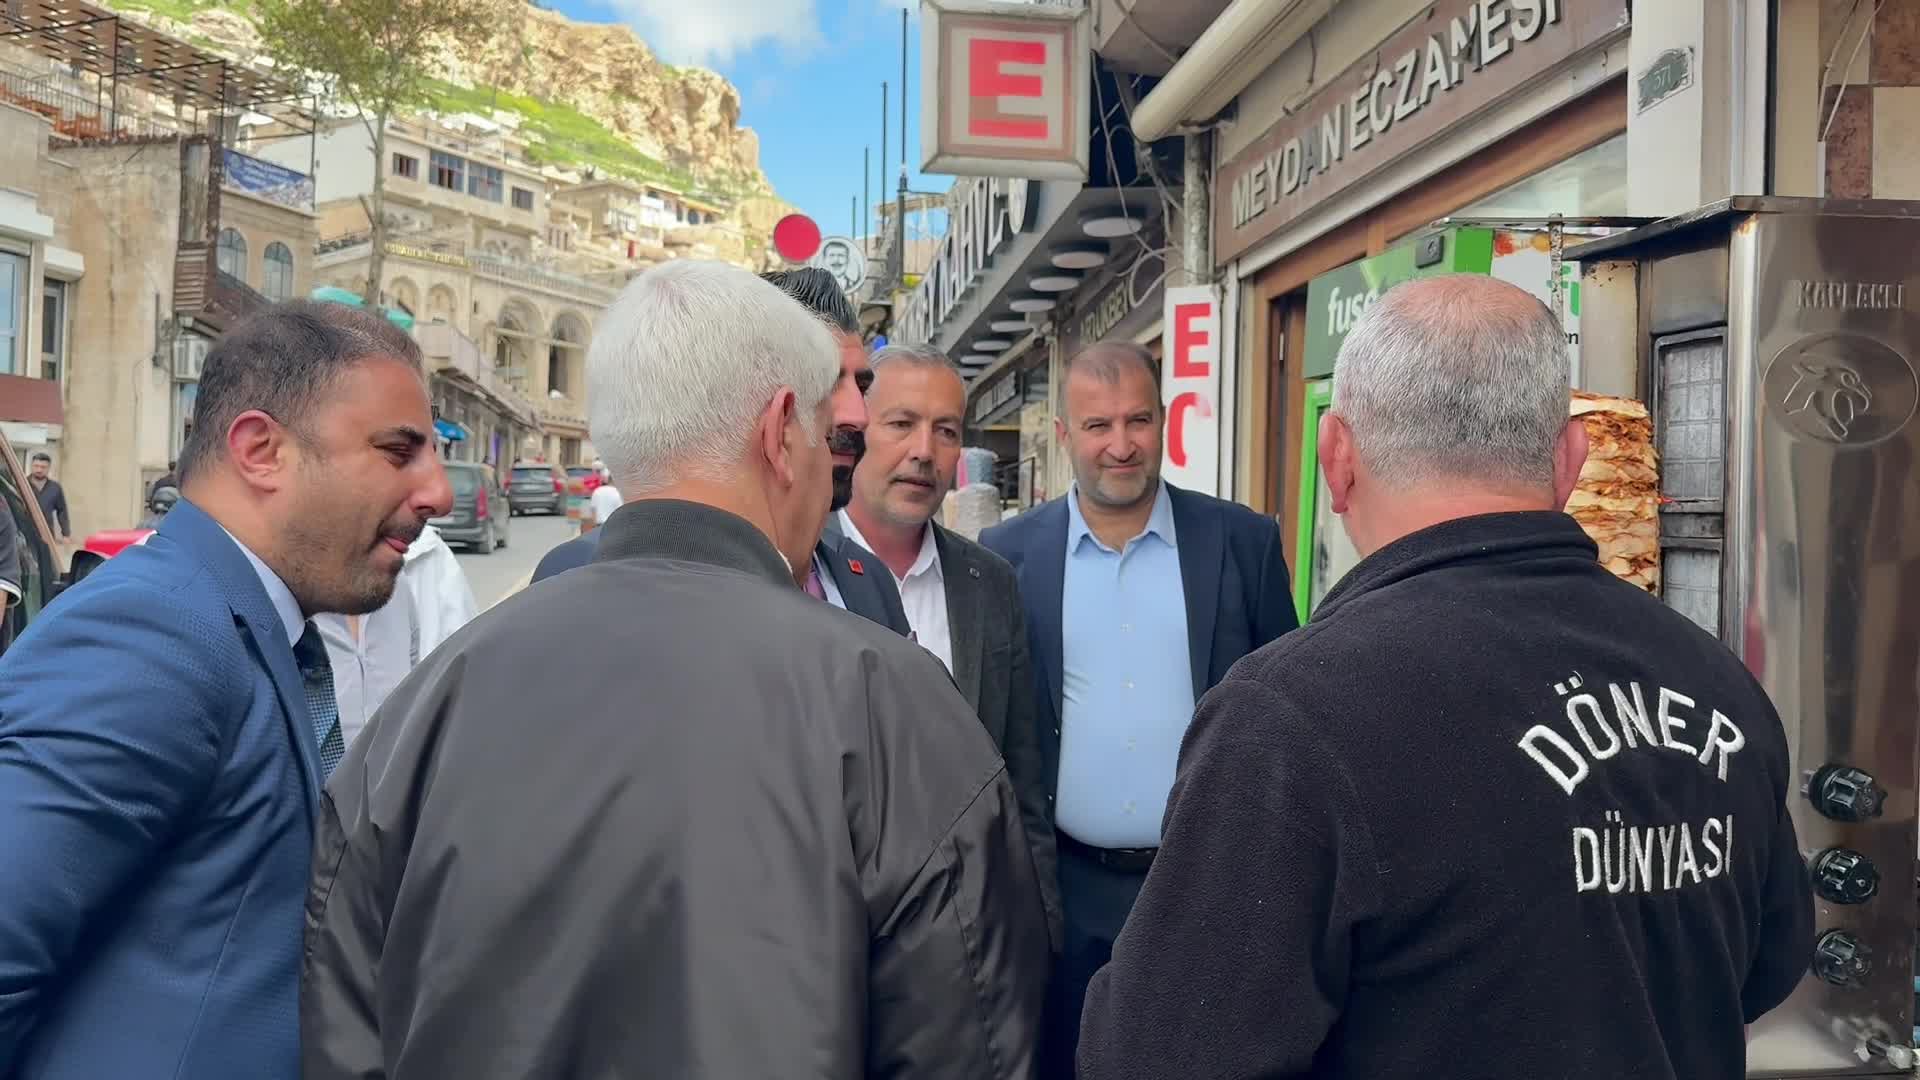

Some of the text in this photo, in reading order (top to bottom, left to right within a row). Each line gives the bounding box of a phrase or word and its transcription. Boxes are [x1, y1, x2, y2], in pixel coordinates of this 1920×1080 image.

[969, 39, 1049, 140] E
[1232, 111, 1342, 230] MEYDAN
[1517, 672, 1746, 796] DÖNER
[1572, 810, 1734, 894] DÜNYASI
